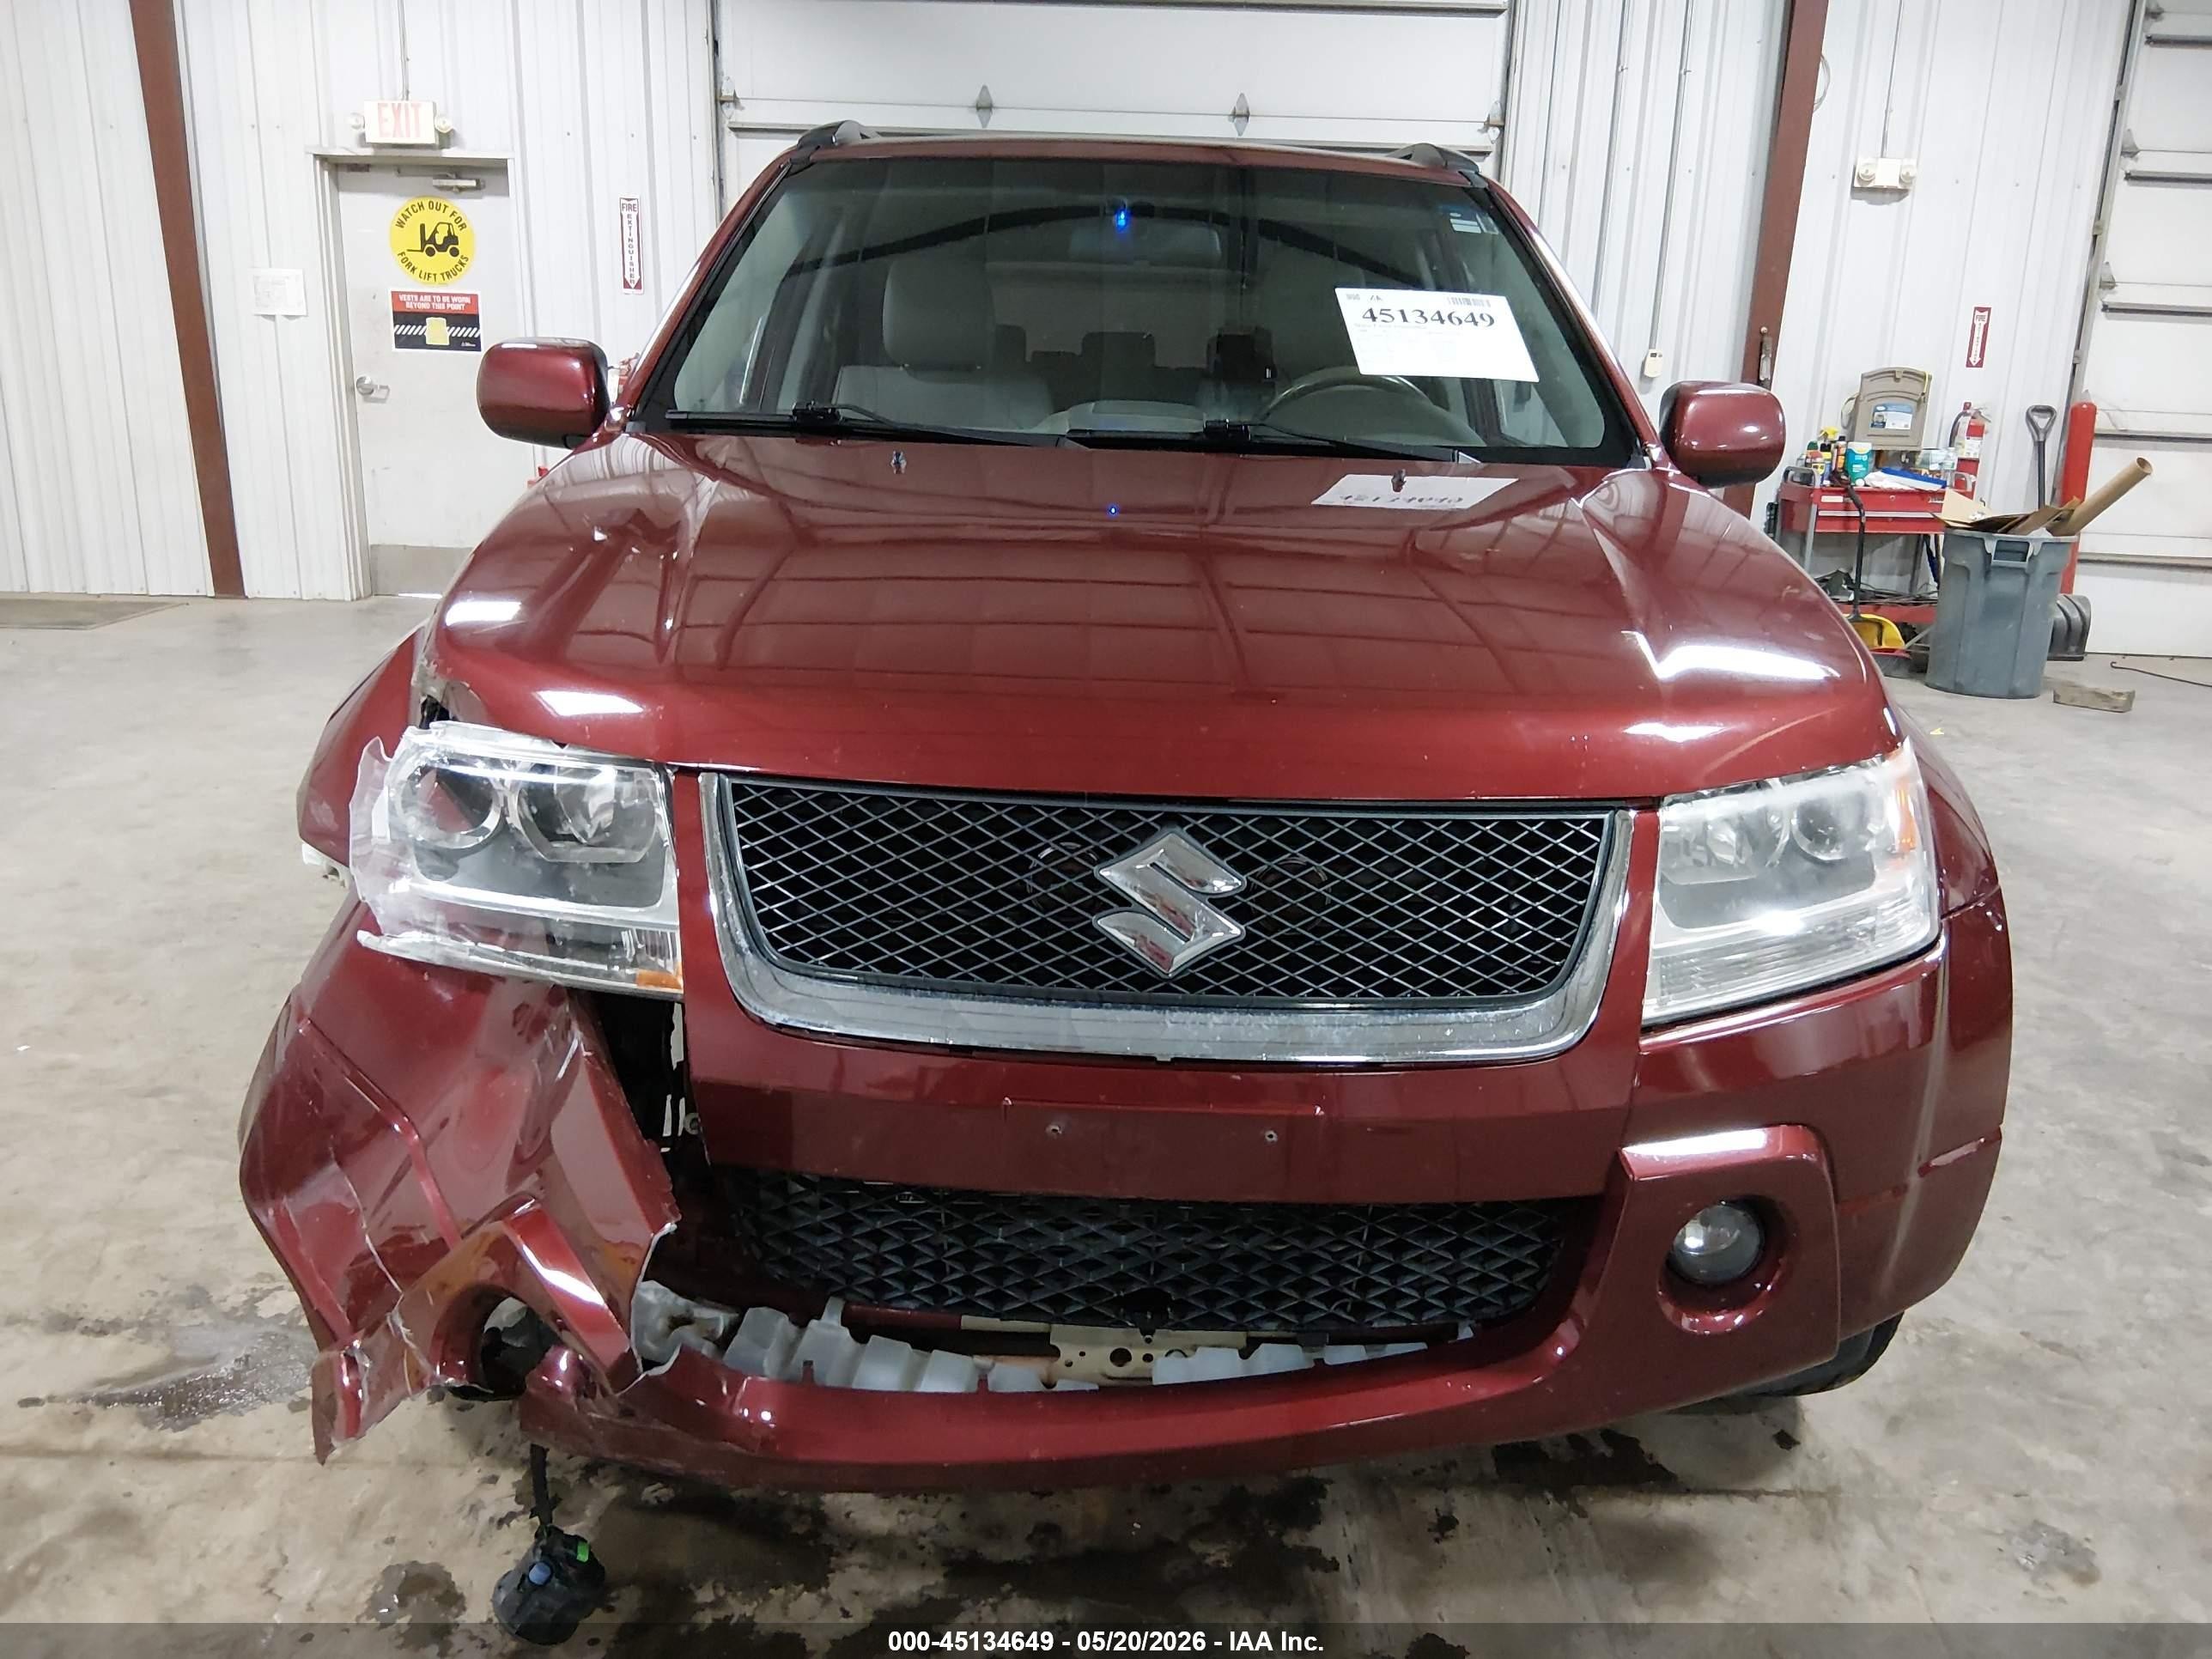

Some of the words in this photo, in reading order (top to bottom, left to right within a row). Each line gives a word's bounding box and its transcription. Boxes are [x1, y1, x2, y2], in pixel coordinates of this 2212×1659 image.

[378, 102, 421, 138] EXIT
[395, 201, 425, 228] WATCH
[428, 200, 449, 214] OUT
[449, 210, 467, 231] FOR
[621, 203, 637, 212] FIRE
[397, 251, 418, 275] FORK
[418, 270, 437, 283] LIFT
[440, 254, 470, 282] TRUCKS
[1362, 307, 1495, 327] 45134649
